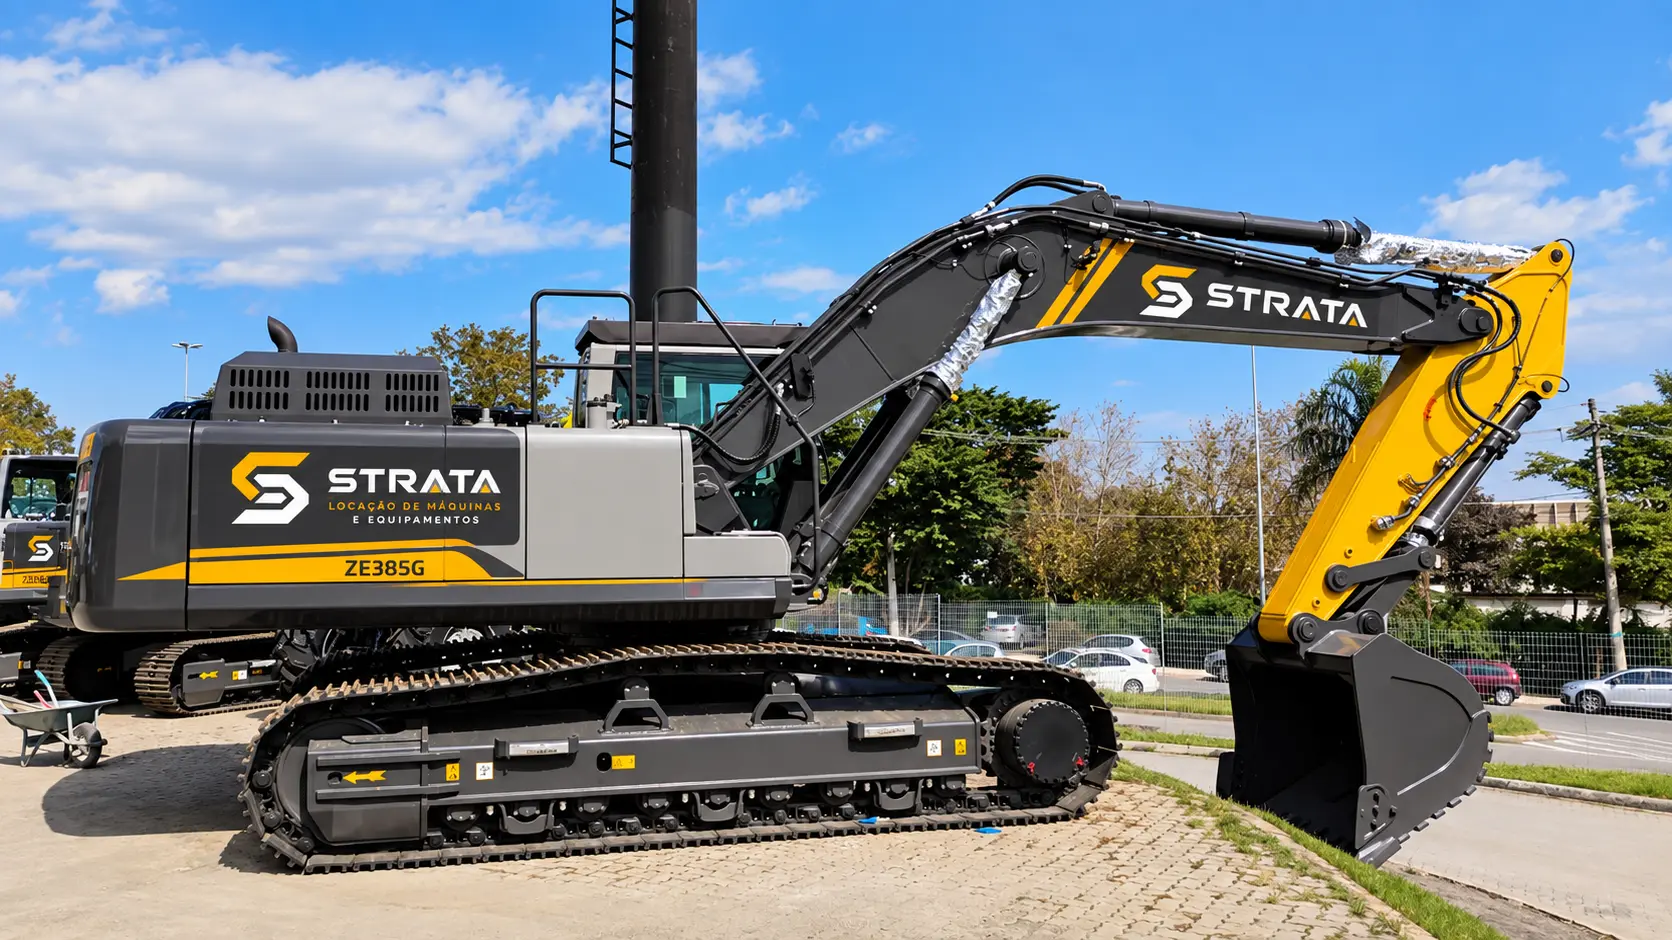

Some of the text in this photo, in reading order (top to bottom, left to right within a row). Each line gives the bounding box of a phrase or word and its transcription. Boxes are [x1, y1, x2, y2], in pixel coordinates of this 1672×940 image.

[1206, 282, 1368, 328] STRATA
[328, 468, 501, 494] STRATA
[328, 500, 501, 512] LOCAÇÃO DE MÁQUINAS
[353, 515, 480, 524] E EQUIPAMENTOS
[344, 559, 425, 577] ZE385G
